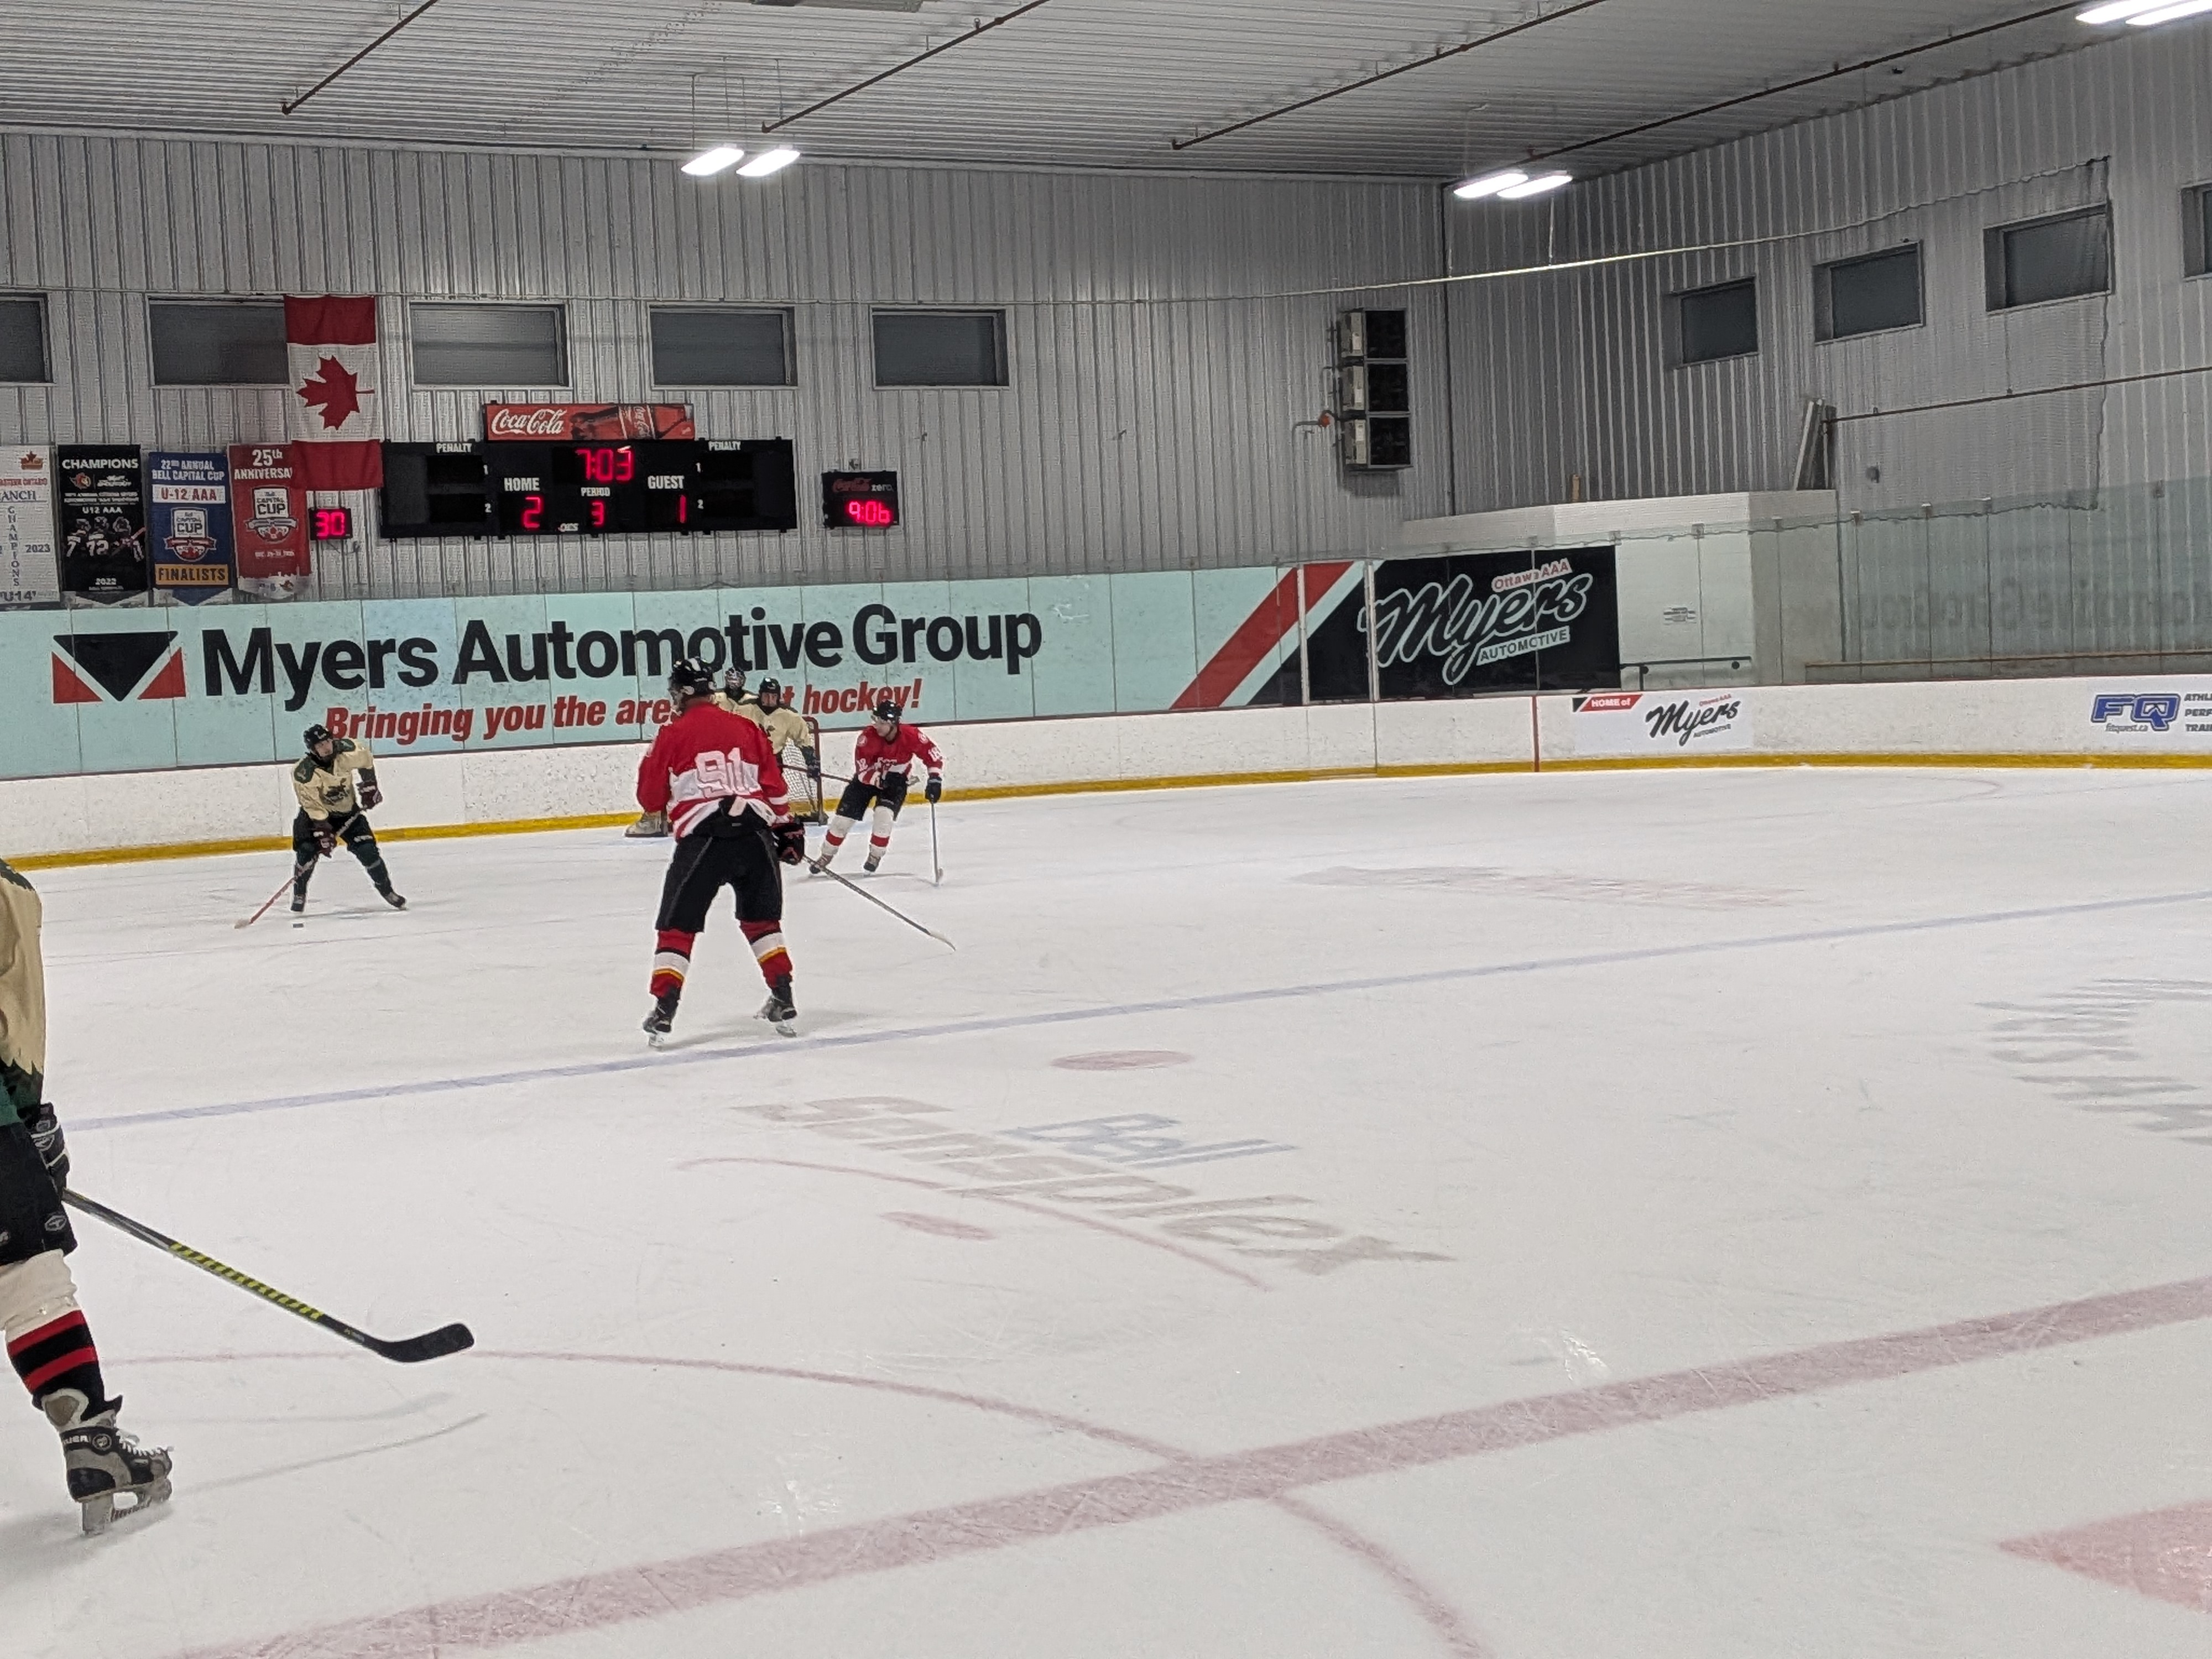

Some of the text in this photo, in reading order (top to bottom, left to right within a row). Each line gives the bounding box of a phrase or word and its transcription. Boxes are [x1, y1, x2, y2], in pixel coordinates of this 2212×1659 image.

[491, 409, 567, 435] Coca-Cola
[436, 443, 472, 453] PENALTY
[708, 441, 741, 451] PENALTY
[62, 458, 138, 469] CHAMPIONS
[252, 448, 283, 466] 25th
[483, 465, 488, 475] 1
[575, 448, 633, 481] 7:03
[696, 462, 701, 473] 1
[152, 469, 225, 481] BELL CAPITAL CUP
[648, 475, 685, 489] GUEST
[504, 478, 540, 492] HOME
[581, 487, 611, 497] PERIOD
[0, 491, 36, 501] ANCH
[161, 487, 217, 500] U-12 AAA
[257, 503, 286, 515] CUP
[485, 503, 492, 513] 2
[697, 499, 704, 509] 2
[523, 497, 542, 528] 2
[591, 502, 604, 525] 3
[849, 501, 891, 524] 9:06
[177, 523, 202, 533] CUP
[316, 512, 345, 537] 30
[25, 544, 50, 553] 2023
[158, 567, 226, 581] FINALISTS
[1542, 561, 1568, 577] AAA
[1357, 573, 1593, 685] Myers
[1481, 629, 1568, 662] AUTOMOTIVE
[202, 603, 1042, 712] Myers Automotive Group
[1592, 698, 1631, 707] HOME of
[2090, 693, 2180, 731] FQ
[325, 693, 673, 746] Bringing you the are
[1645, 700, 1741, 746] Myers
[694, 747, 750, 799] 91
